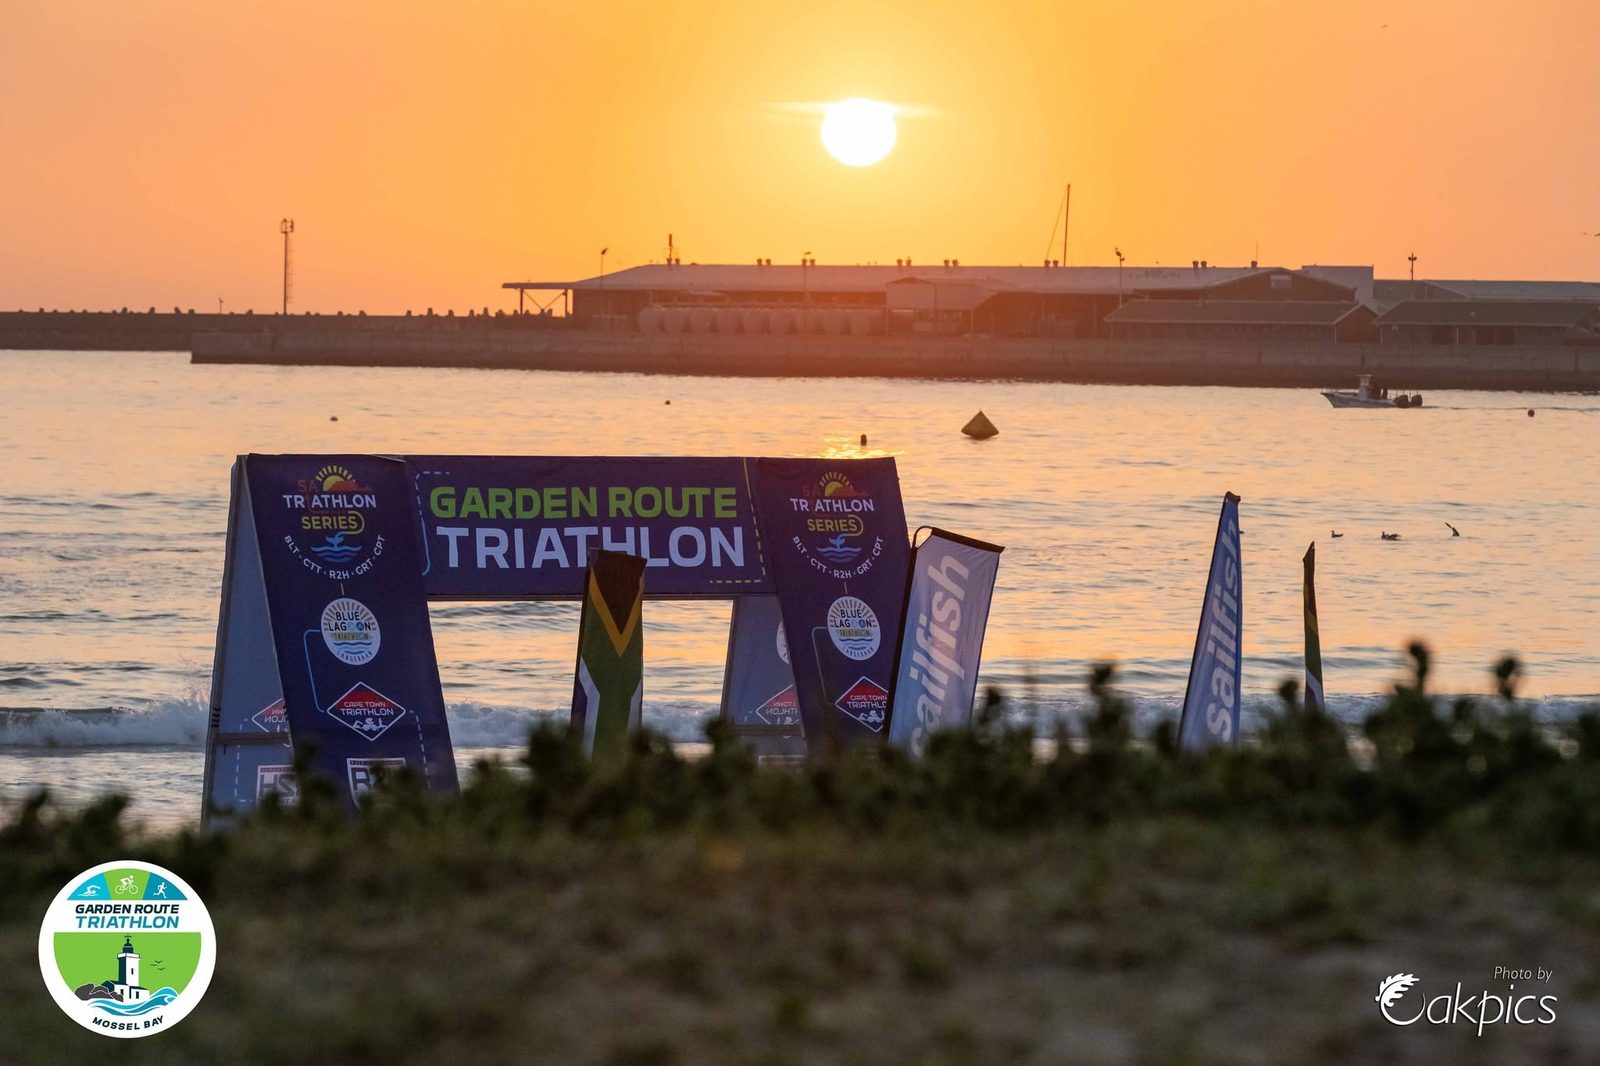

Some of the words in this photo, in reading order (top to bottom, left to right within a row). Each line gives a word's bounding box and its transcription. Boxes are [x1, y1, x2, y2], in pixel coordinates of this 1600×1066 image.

[297, 479, 318, 492] SA
[430, 486, 598, 519] GARDEN
[608, 486, 738, 518] ROUTE
[302, 516, 359, 530] SERIES
[807, 518, 857, 532] SERIES
[436, 526, 745, 569] TRIATHLON
[284, 535, 300, 554] BLT
[303, 558, 322, 574] CTT
[329, 570, 350, 580] R2H
[355, 558, 374, 575] GRT
[373, 534, 385, 556] CPT
[793, 536, 807, 554] BLT
[810, 558, 828, 573] CTT
[833, 569, 852, 579] R2H
[856, 559, 873, 575] GRT
[872, 536, 884, 556] CPT
[336, 611, 361, 620] BLUE
[840, 609, 862, 618] BLUE
[1205, 518, 1239, 743] sailfish
[340, 708, 394, 716] TRIATHLON
[847, 701, 887, 709] TRIATHLO
